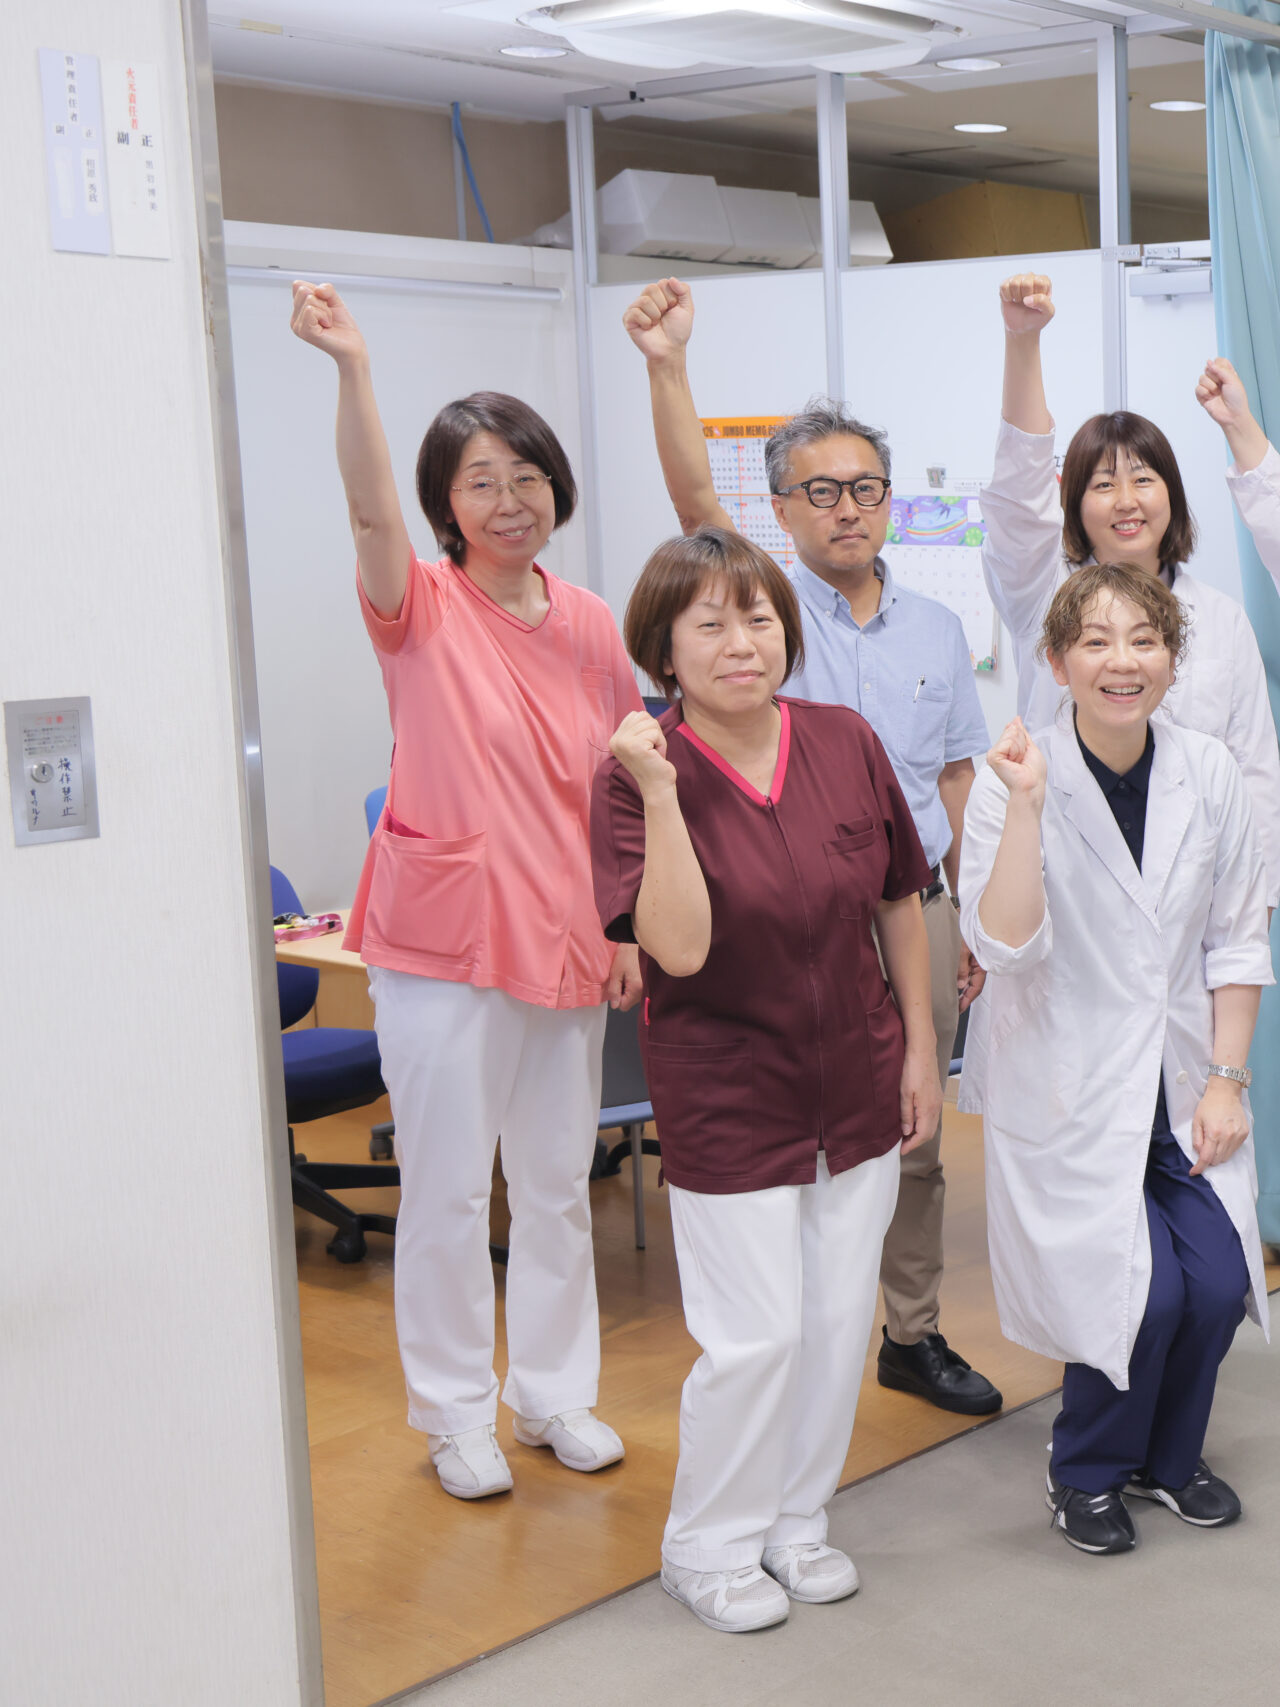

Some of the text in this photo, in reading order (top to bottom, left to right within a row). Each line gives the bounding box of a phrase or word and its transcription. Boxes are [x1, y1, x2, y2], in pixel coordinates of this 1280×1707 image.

[65, 56, 77, 121] 管理責任者
[126, 67, 139, 130] 火元責任者
[117, 131, 130, 145] 副
[142, 135, 154, 148] 正
[723, 426, 745, 437] JUMBO
[891, 510, 902, 527] 6
[57, 757, 77, 817] 操作禁止
